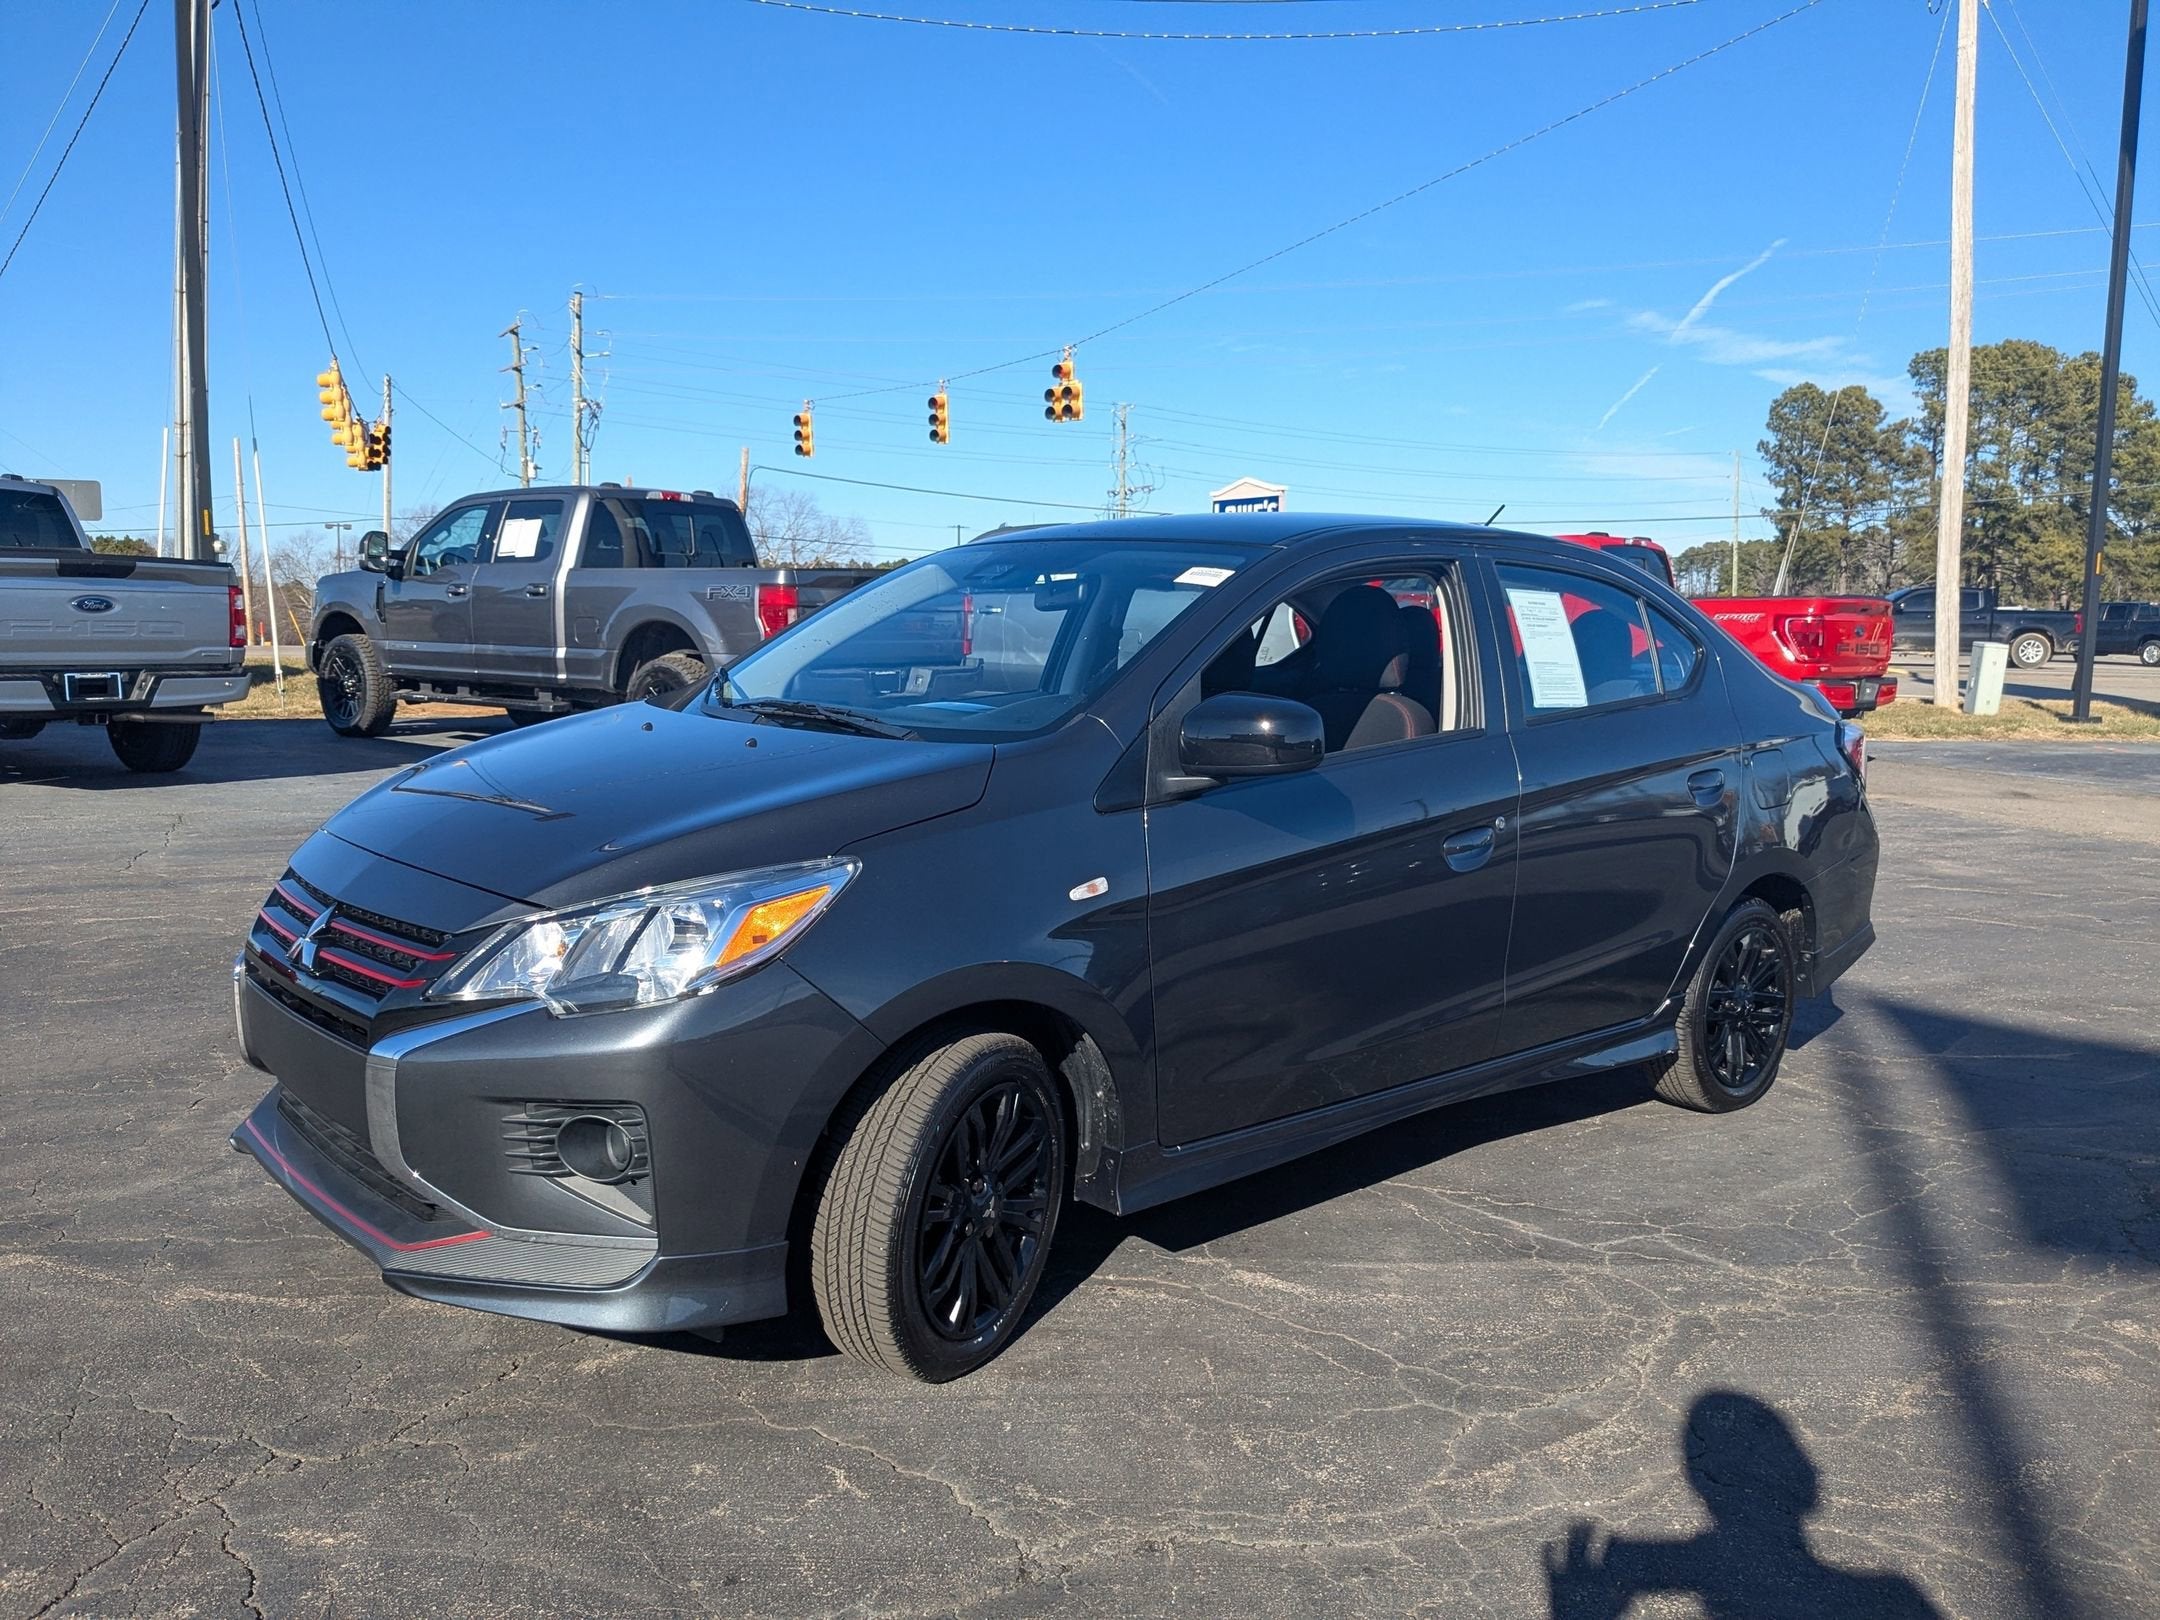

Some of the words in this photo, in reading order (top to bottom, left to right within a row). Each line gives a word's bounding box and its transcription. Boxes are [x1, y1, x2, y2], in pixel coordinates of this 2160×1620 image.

[705, 584, 752, 601] FX4
[81, 599, 108, 610] Ford
[1835, 642, 1880, 656] F-150
